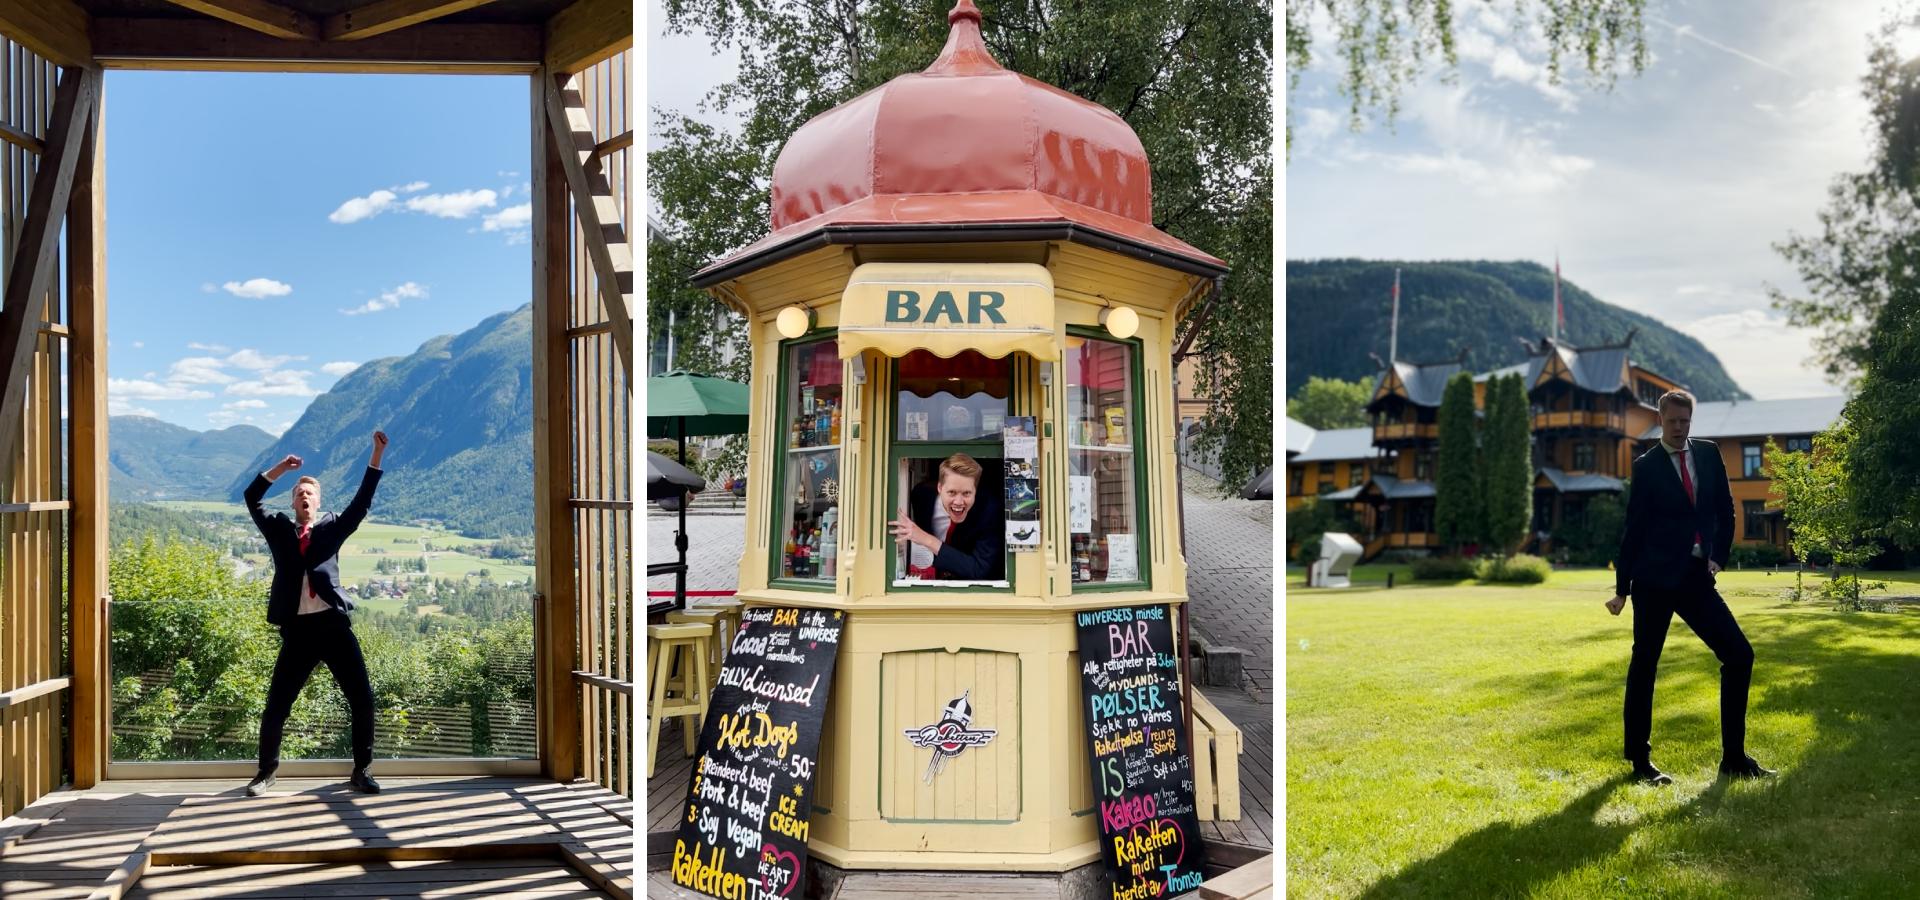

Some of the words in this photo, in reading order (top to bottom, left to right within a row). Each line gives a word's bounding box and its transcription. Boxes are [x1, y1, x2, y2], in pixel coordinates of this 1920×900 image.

[885, 290, 1007, 324] BAR
[753, 609, 774, 622] tiniest
[773, 609, 799, 626] BAR
[803, 611, 811, 624] in
[812, 611, 826, 627] the
[1078, 607, 1133, 627] UNIVERSETS
[1135, 606, 1164, 620] minste
[731, 629, 768, 656] Cocoa
[798, 627, 840, 643] UNIVERSE
[1108, 620, 1154, 659] BAR
[1083, 660, 1100, 675] Alle
[1103, 654, 1144, 675] rettigheter
[1146, 652, 1158, 672] på
[717, 666, 750, 687] FULLY
[743, 665, 820, 707] Licensed
[737, 703, 751, 717] The
[751, 697, 770, 713] best
[1091, 685, 1165, 721] PØLSER
[717, 713, 752, 750] Hot
[753, 713, 798, 759] Dogs
[920, 723, 984, 747] Raketten
[1092, 717, 1123, 738] Sjekk
[1127, 717, 1138, 727] no
[735, 749, 744, 761] the
[1094, 728, 1144, 758] Rakettpølsa
[1150, 728, 1167, 741] rein
[1167, 728, 1176, 743] og
[1153, 739, 1177, 756] Storfe
[704, 757, 741, 782] Reindeer
[739, 765, 748, 784] &
[749, 768, 776, 802] beef
[1100, 757, 1125, 797] IS
[1153, 761, 1169, 780] Soft
[1169, 761, 1178, 773] is
[701, 777, 726, 804] Pork
[728, 784, 739, 810] &
[741, 790, 769, 831] beef
[779, 794, 797, 816] ICE
[1101, 793, 1156, 834] Kakao
[688, 805, 698, 822] 3:
[699, 806, 720, 845] Soy
[727, 817, 762, 858] Vegan
[769, 811, 809, 843] CREAM
[1114, 820, 1177, 867] Raketten
[671, 839, 747, 900] Raketten
[764, 852, 777, 865] The
[1132, 853, 1155, 876] midt
[1159, 849, 1163, 864] i
[757, 861, 791, 885] HEART
[767, 877, 778, 895] of
[1149, 879, 1161, 896] av
